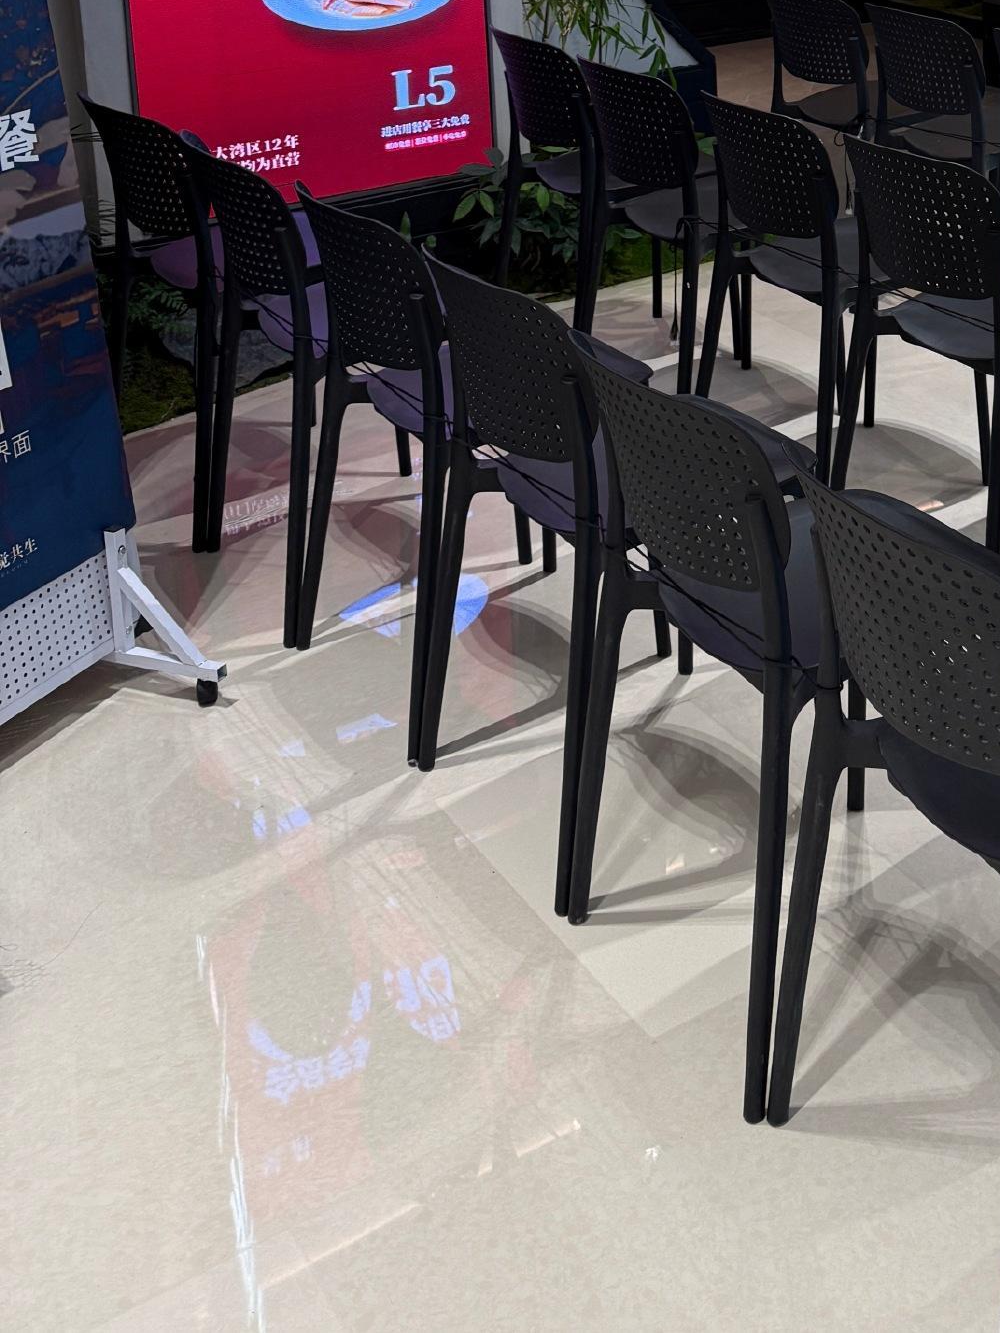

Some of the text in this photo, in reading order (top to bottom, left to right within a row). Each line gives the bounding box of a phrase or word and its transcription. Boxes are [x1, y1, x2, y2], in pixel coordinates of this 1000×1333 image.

[391, 64, 456, 111] L5
[237, 151, 300, 173] 均为直营
